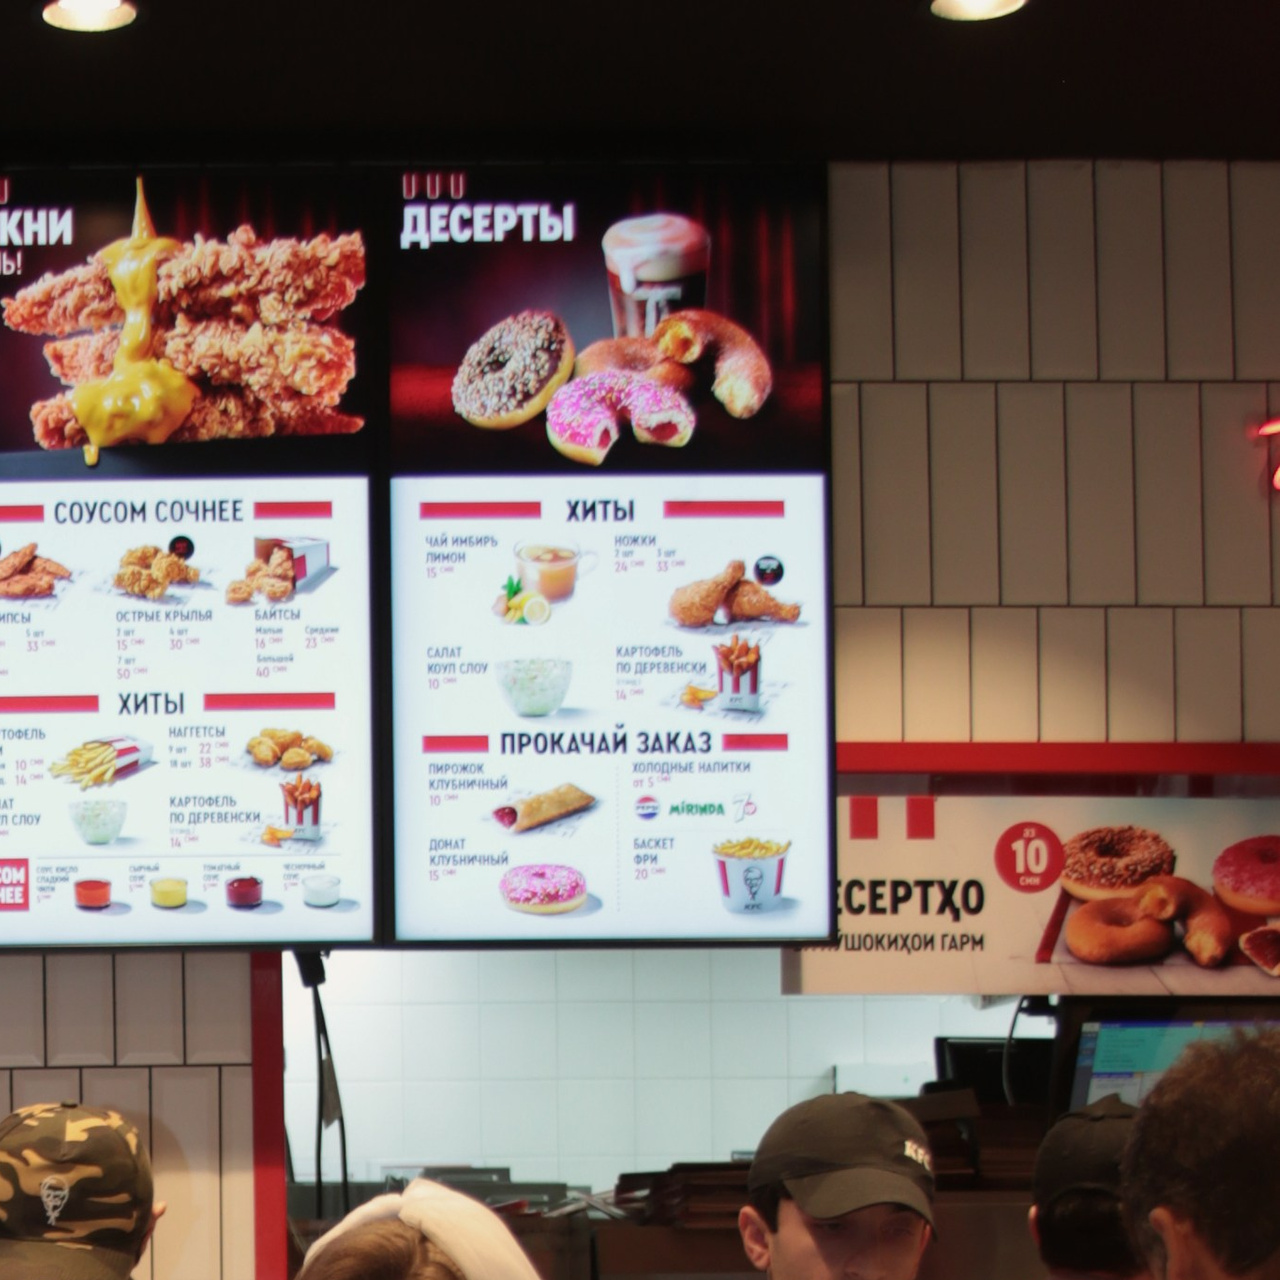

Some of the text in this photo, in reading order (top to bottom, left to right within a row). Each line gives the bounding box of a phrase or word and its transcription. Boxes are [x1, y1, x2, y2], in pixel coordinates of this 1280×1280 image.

[400, 203, 574, 249] ДЕСЕРТЫ
[54, 499, 244, 524] СОУСОМ СОЧНЕЕ
[566, 500, 635, 522] ХИТЫ
[425, 532, 498, 548] ЧАЙ ИМБИРЬ
[614, 535, 656, 547] НОЖКИ
[426, 552, 466, 564] ЛИМОН
[427, 566, 437, 578] 15
[615, 560, 628, 572] 24
[657, 560, 669, 572] 33
[116, 610, 213, 623] ОСТРЫЕ КРЫЛЬЯ
[255, 606, 300, 620] БАЙТСЫ
[27, 641, 39, 652] 33
[117, 639, 128, 651] 15
[169, 638, 183, 650] 30
[255, 638, 266, 649] 16
[305, 637, 317, 648] 23
[427, 647, 462, 659] САЛАТ
[616, 646, 683, 658] КАРТОФЕЛЬ
[117, 668, 130, 680] 50
[256, 666, 270, 678] 40
[427, 662, 488, 675] КОУЛ СЛОУ
[616, 662, 707, 675] ПО ДЕРЕВЕНСКИ
[428, 678, 440, 690] 10
[616, 689, 627, 701] 14
[119, 692, 184, 715] ХИТЫ
[169, 726, 225, 738] НАГГЕТСЫ
[500, 723, 712, 755] ПРОКАЧАЙ ЗАКАЗ
[199, 742, 211, 754] 22
[16, 759, 27, 770] 10
[199, 757, 211, 768] 38
[632, 761, 751, 775] ХОЛОДНЫЕ НАПИТКИ
[429, 763, 484, 775] ПИРОЖОК
[16, 774, 27, 785] 14
[429, 775, 508, 790] КЛУБНИЧНЫЙ
[647, 776, 654, 788] 5
[170, 795, 237, 808] КАРТОФЕЛЬ
[430, 794, 441, 806] 10
[12, 814, 41, 826] СЛОУ
[170, 811, 260, 825] ПО ДЕРЕВЕНСКИ
[170, 837, 181, 848] 14
[429, 838, 465, 852] ДОНАТ
[633, 838, 674, 850] БАСКЕТ
[429, 851, 508, 866] КЛУБНИЧНЫЙ
[634, 854, 658, 865] ФРИ
[1011, 839, 1048, 876] 10
[429, 870, 439, 881] 15
[635, 868, 648, 880] 20
[941, 934, 984, 951] ГАРМ
